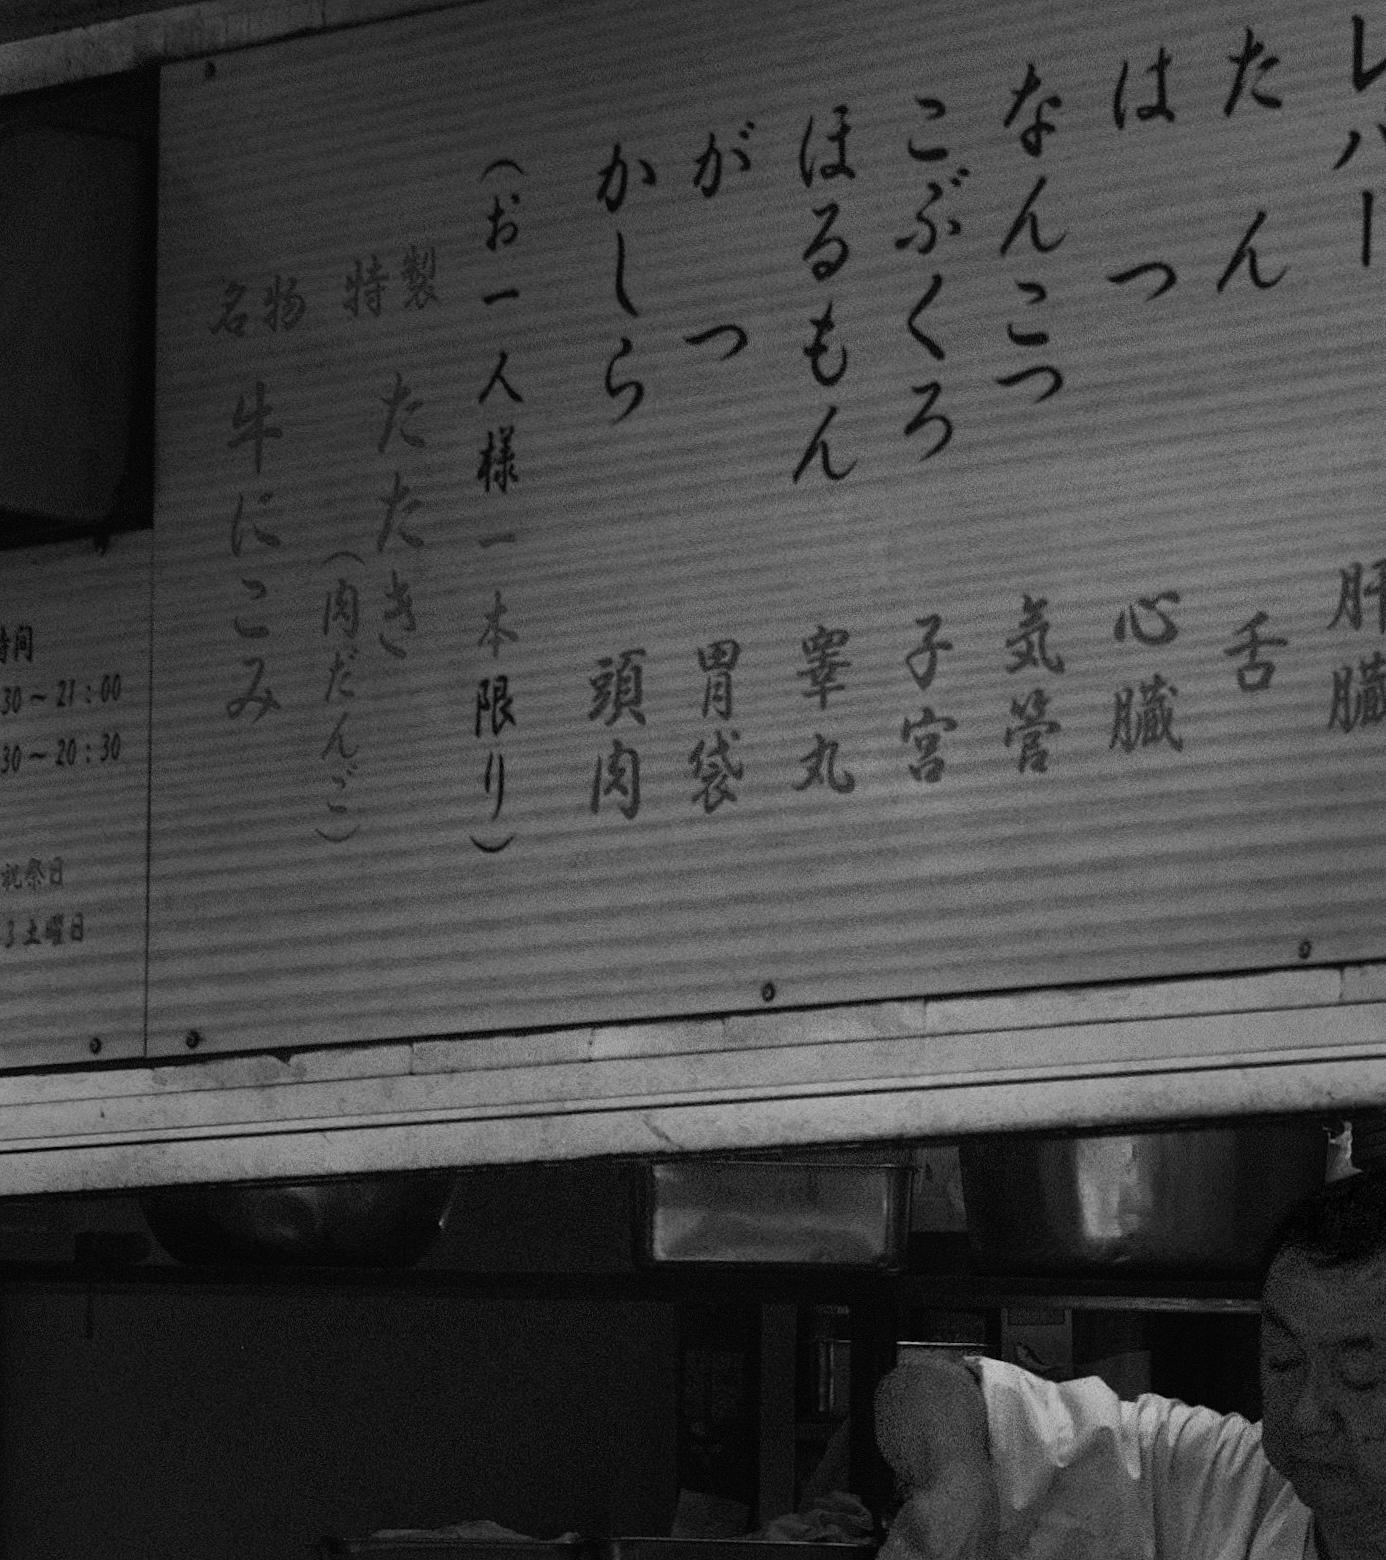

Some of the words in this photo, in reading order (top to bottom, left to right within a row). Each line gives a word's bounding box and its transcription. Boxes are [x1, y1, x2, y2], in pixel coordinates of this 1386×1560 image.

[685, 121, 755, 358] がつ
[893, 95, 972, 461] こぶくろ
[994, 61, 1066, 403] なんこつ
[1107, 47, 1178, 301] はつ
[1216, 27, 1289, 294] たん
[209, 275, 306, 339] 名物
[344, 243, 440, 318] 特製
[595, 142, 657, 423] かしら
[791, 104, 858, 484] ほるもん
[227, 380, 283, 723] 牛にこみ
[378, 373, 426, 659] たたき
[589, 648, 648, 822] 頭肉
[687, 639, 744, 815] 胃袋
[898, 616, 972, 785] 子宮
[1002, 595, 1066, 776] 気管
[1111, 589, 1185, 753] 心臓
[1223, 611, 1290, 693] 舌
